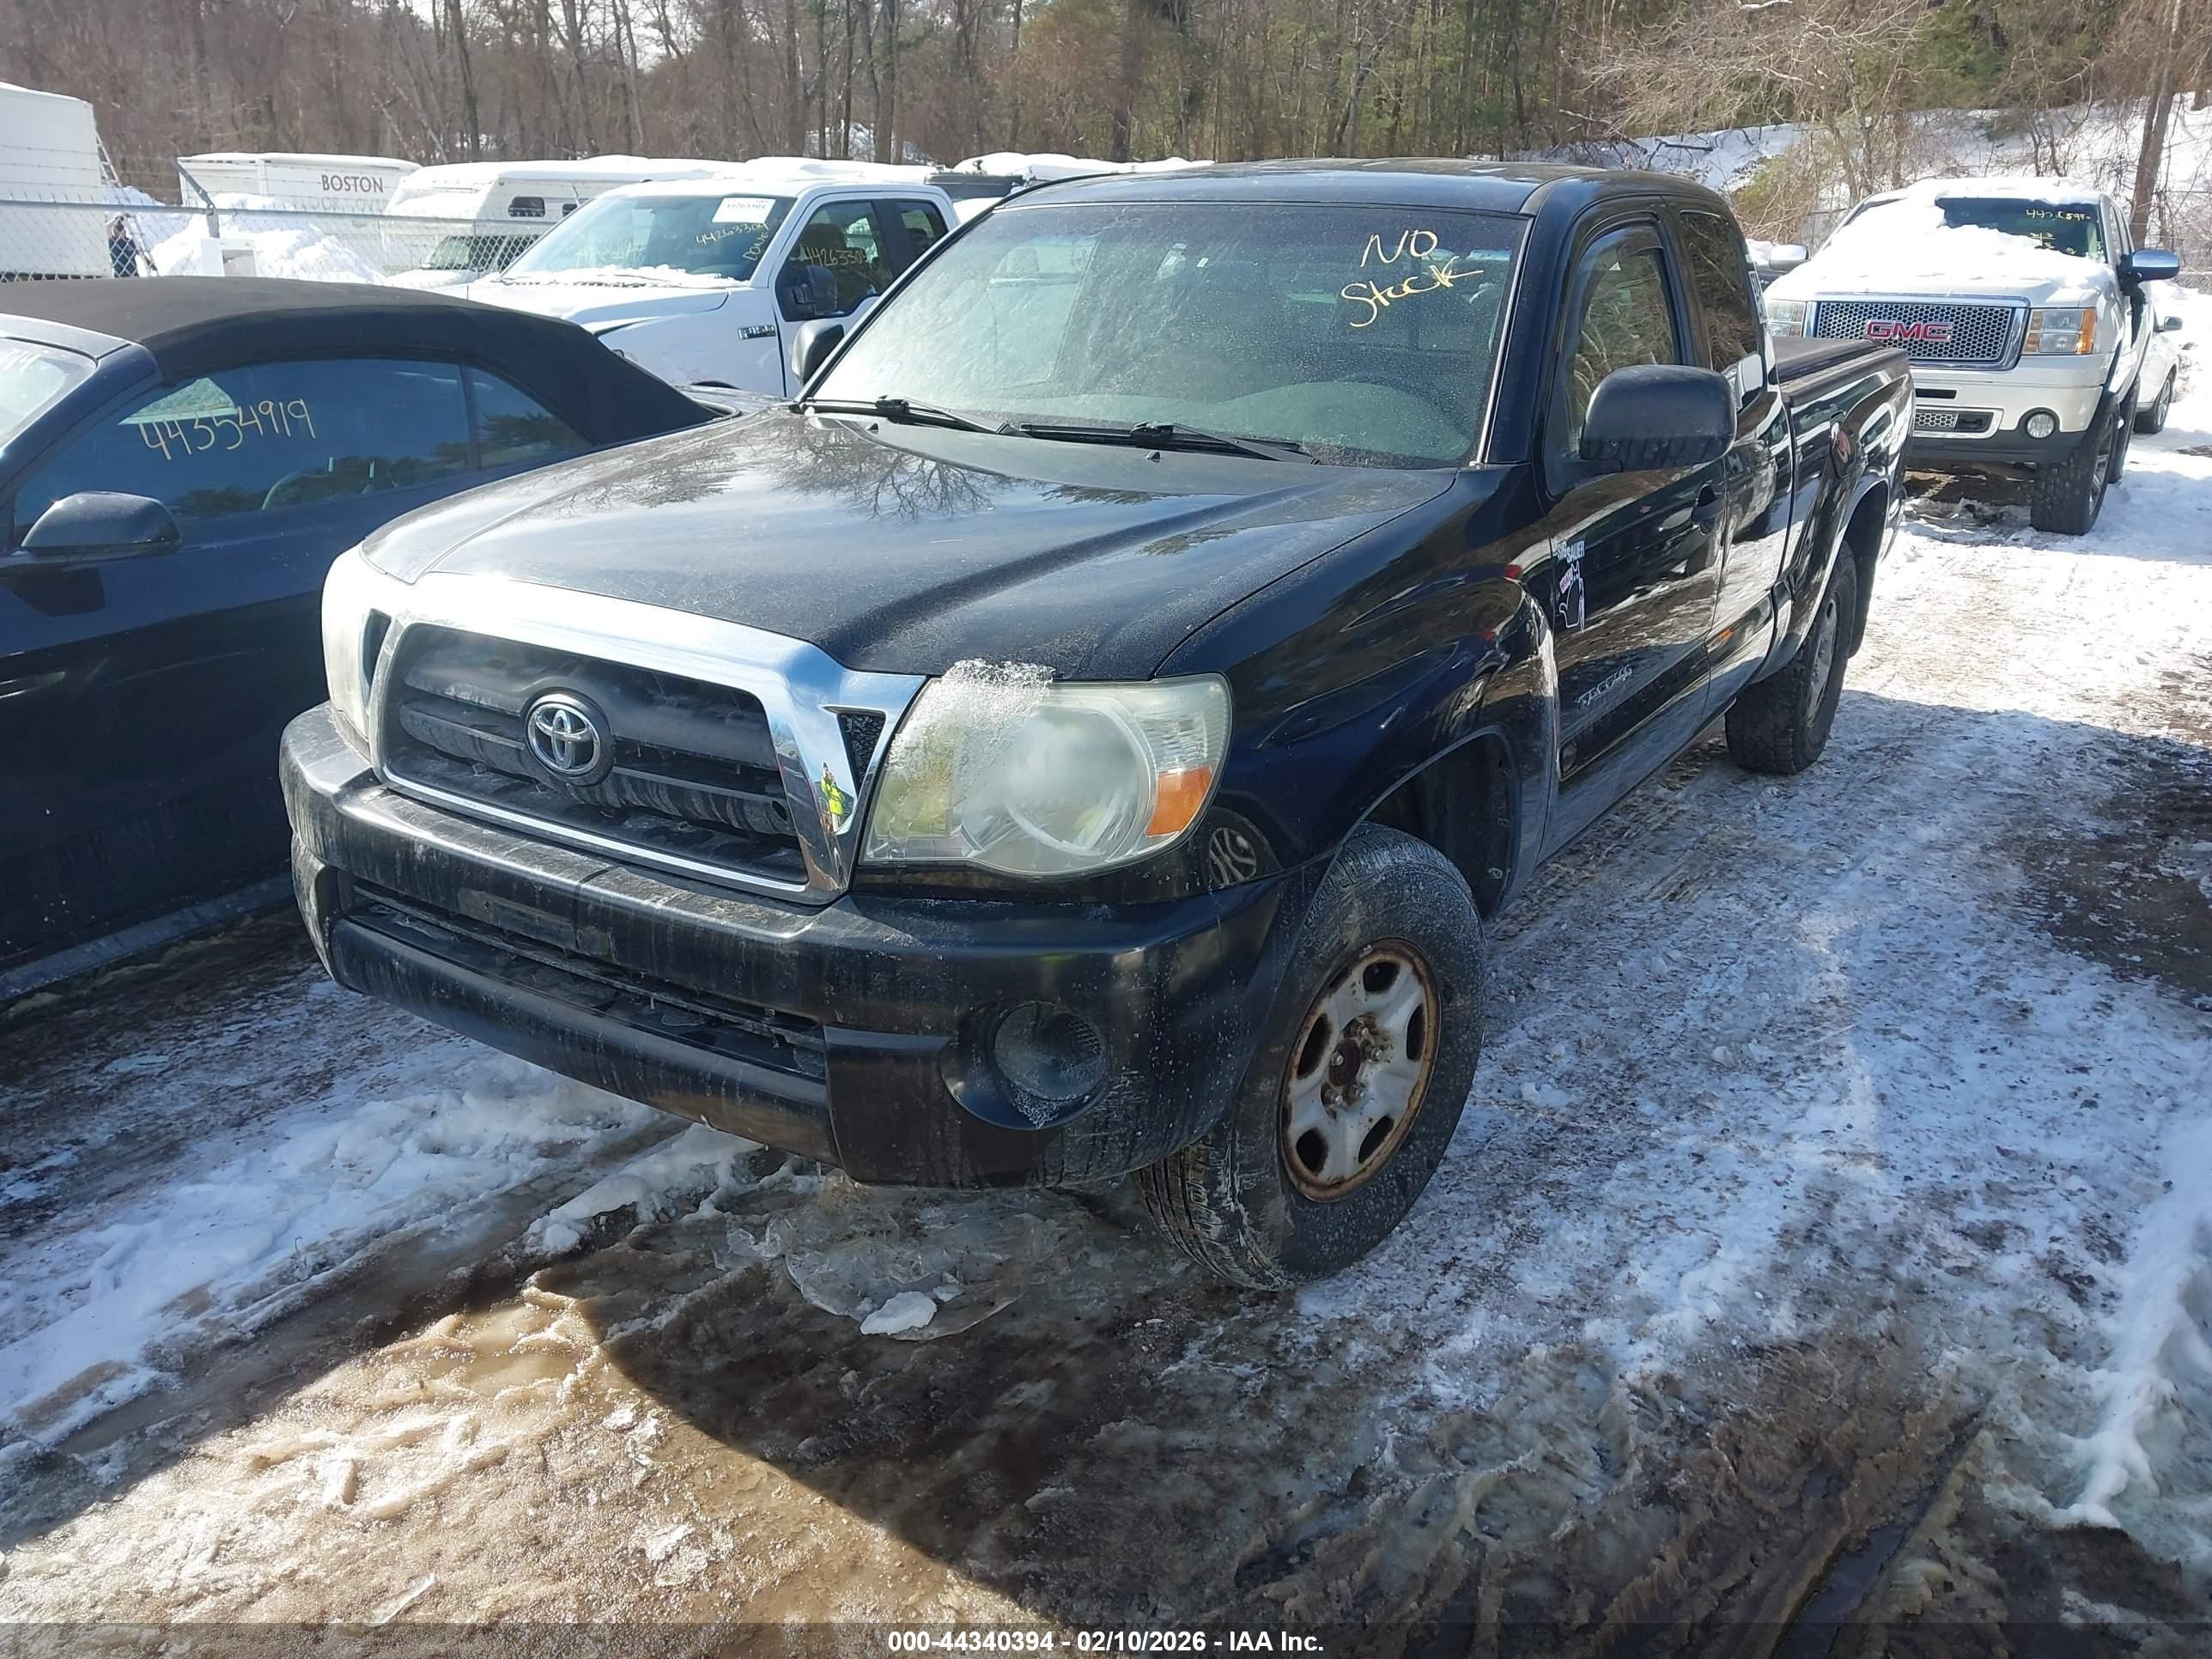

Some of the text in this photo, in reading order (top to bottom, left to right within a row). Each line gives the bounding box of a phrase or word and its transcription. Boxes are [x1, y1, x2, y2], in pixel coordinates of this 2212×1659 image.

[322, 174, 383, 192] BOSTON
[1360, 229, 1438, 268] NO
[1865, 320, 1952, 341] GMC
[138, 398, 316, 460] 44354919
